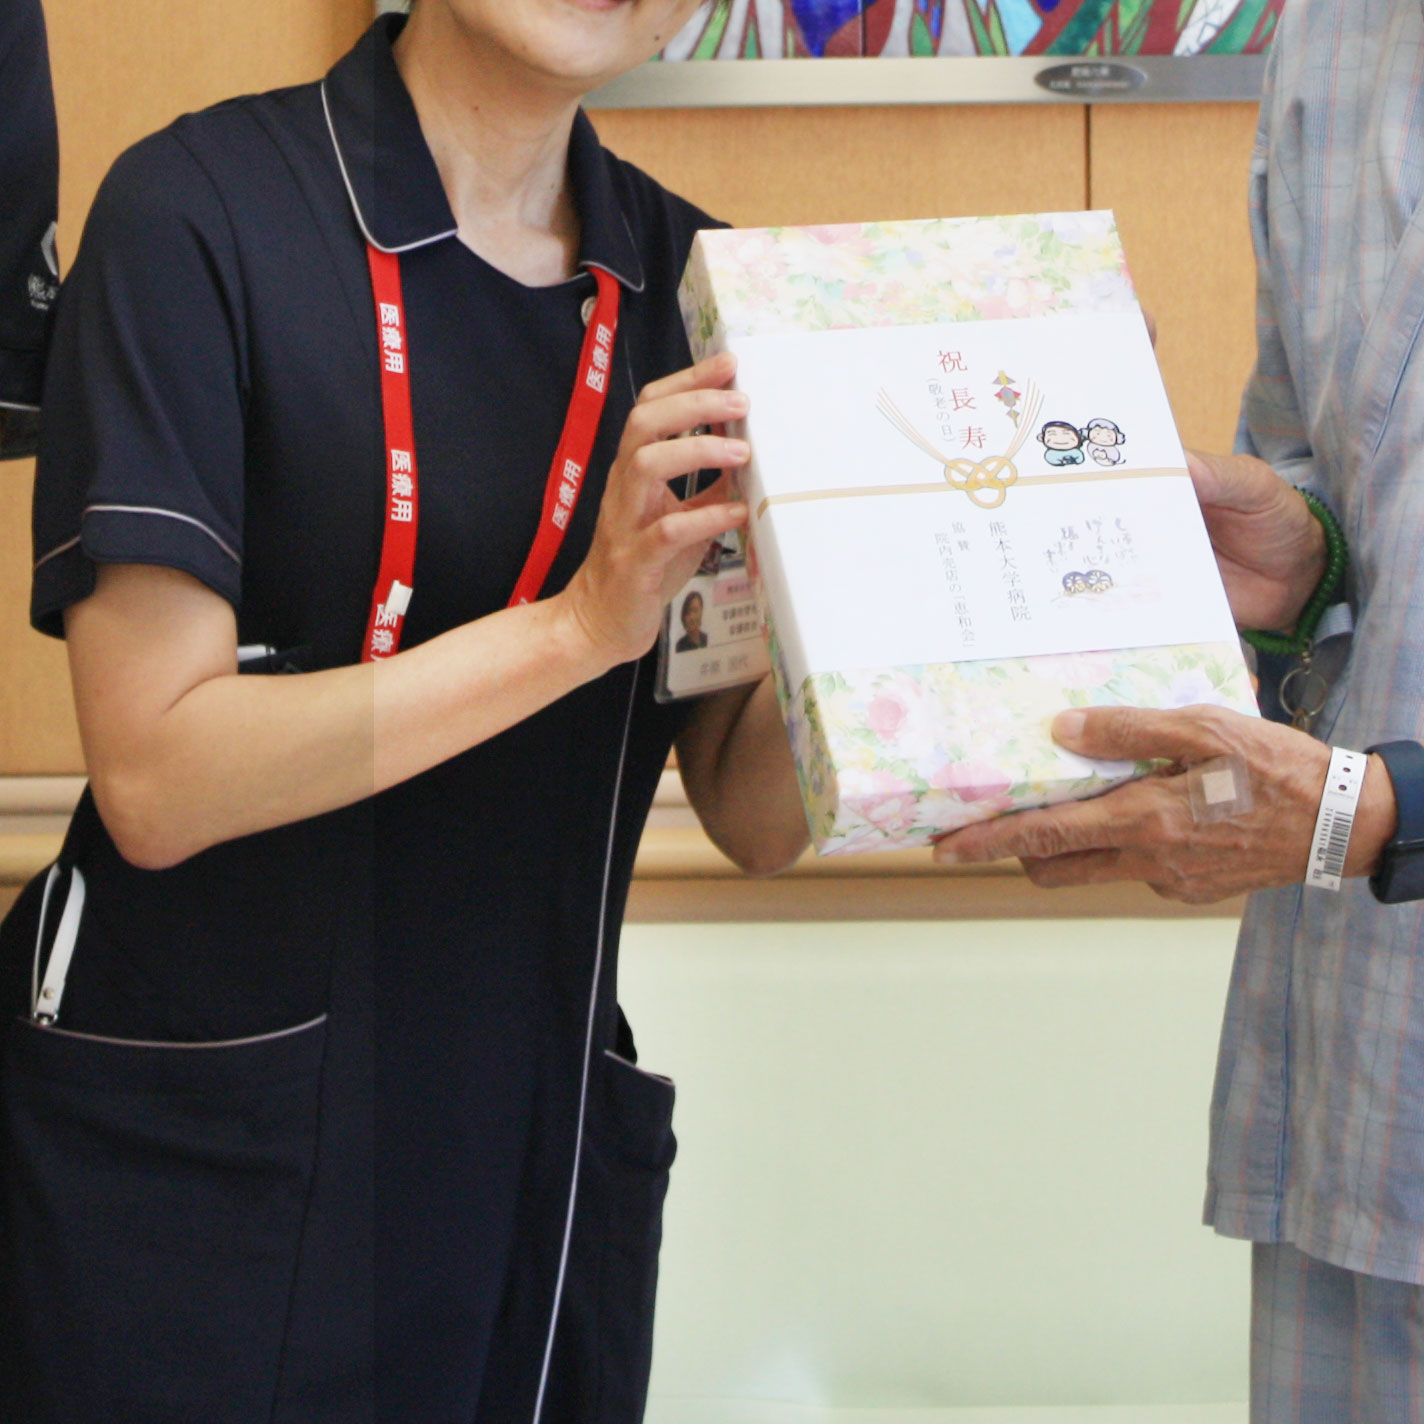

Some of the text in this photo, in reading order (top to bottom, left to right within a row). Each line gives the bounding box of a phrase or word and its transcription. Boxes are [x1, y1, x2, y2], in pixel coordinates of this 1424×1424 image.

[379, 302, 404, 374] 医療用
[586, 323, 612, 394] 医療用
[936, 349, 987, 449] 祝長寿
[390, 449, 413, 522] 医療用
[551, 459, 582, 530] 医療用
[989, 520, 1032, 622] 熊本大学病院
[370, 604, 397, 661] 医療
